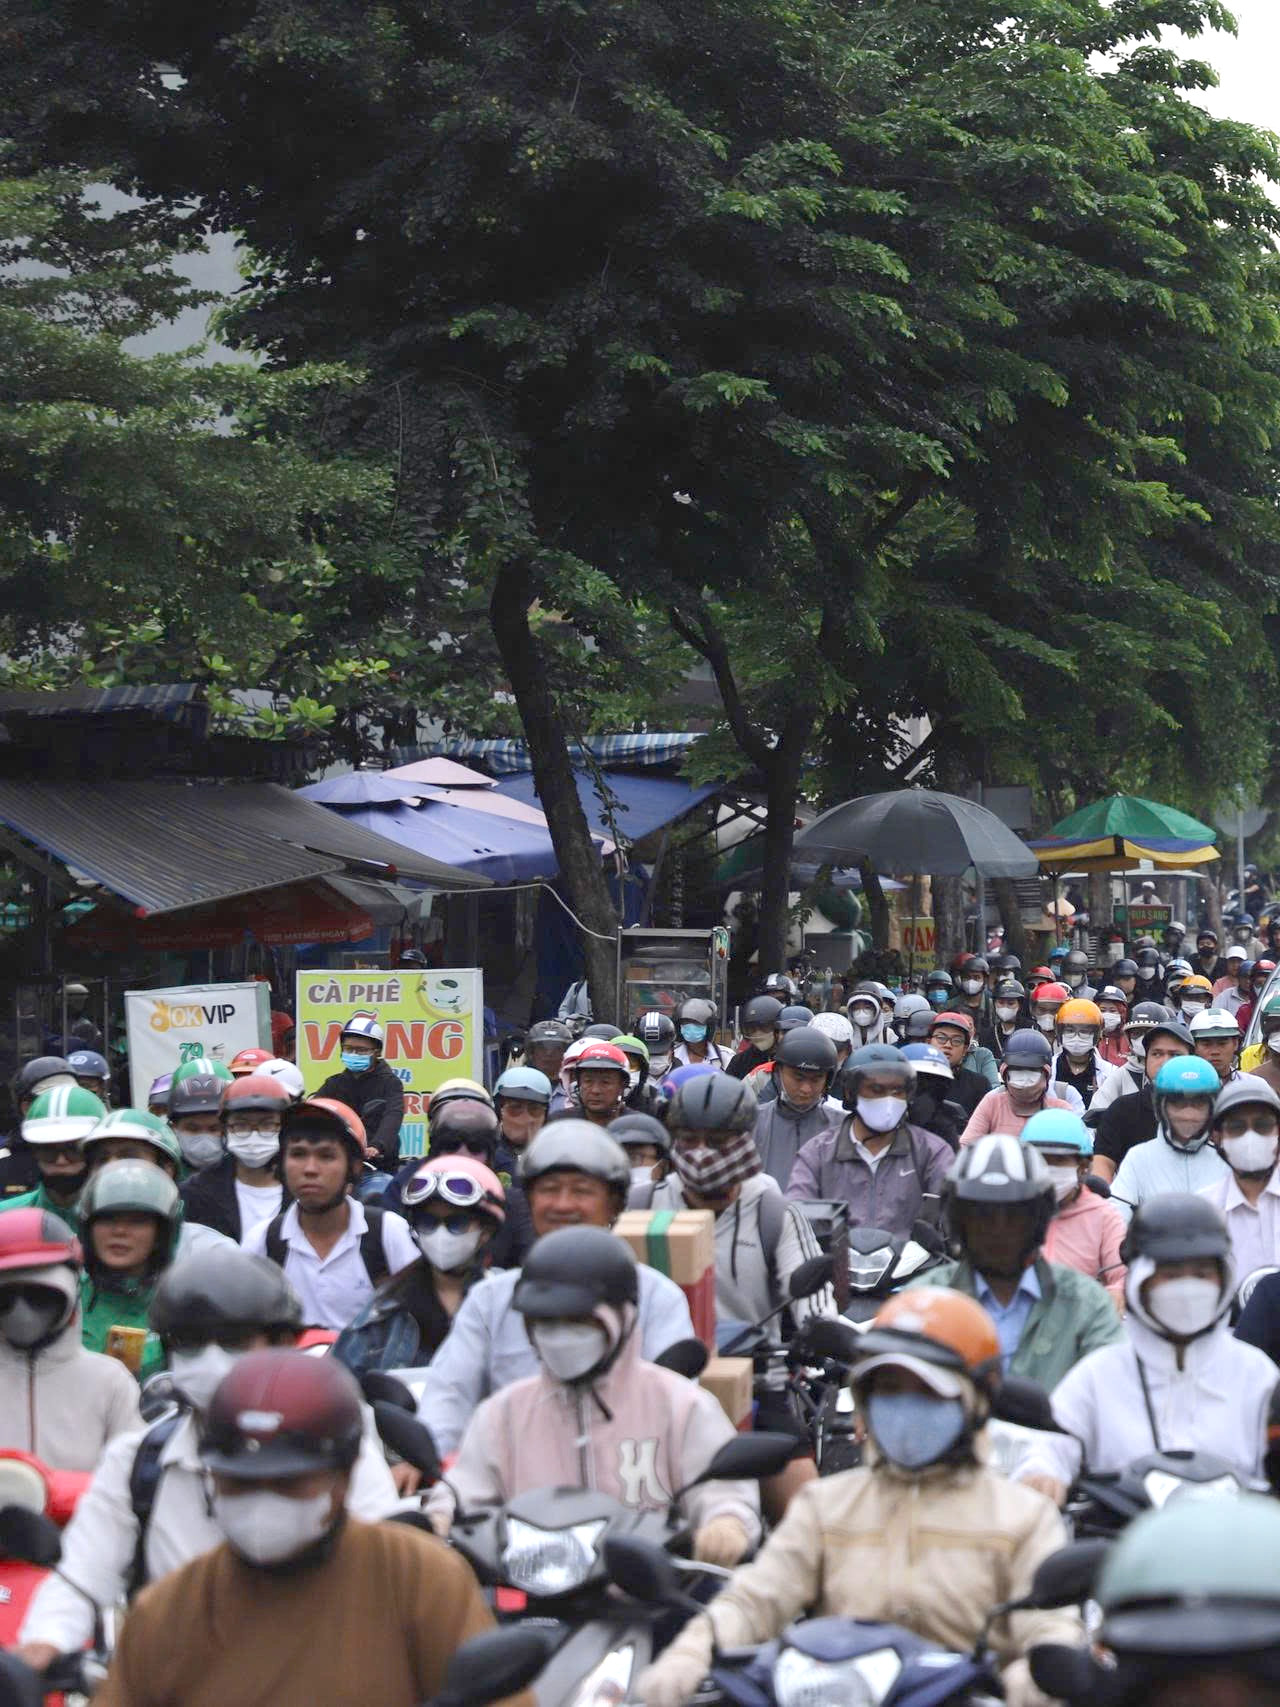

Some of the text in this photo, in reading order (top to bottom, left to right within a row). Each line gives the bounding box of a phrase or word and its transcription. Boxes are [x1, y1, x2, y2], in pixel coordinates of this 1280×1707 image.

[308, 978, 400, 1003] CÀ PHÊ
[303, 1010, 464, 1062] VNG
